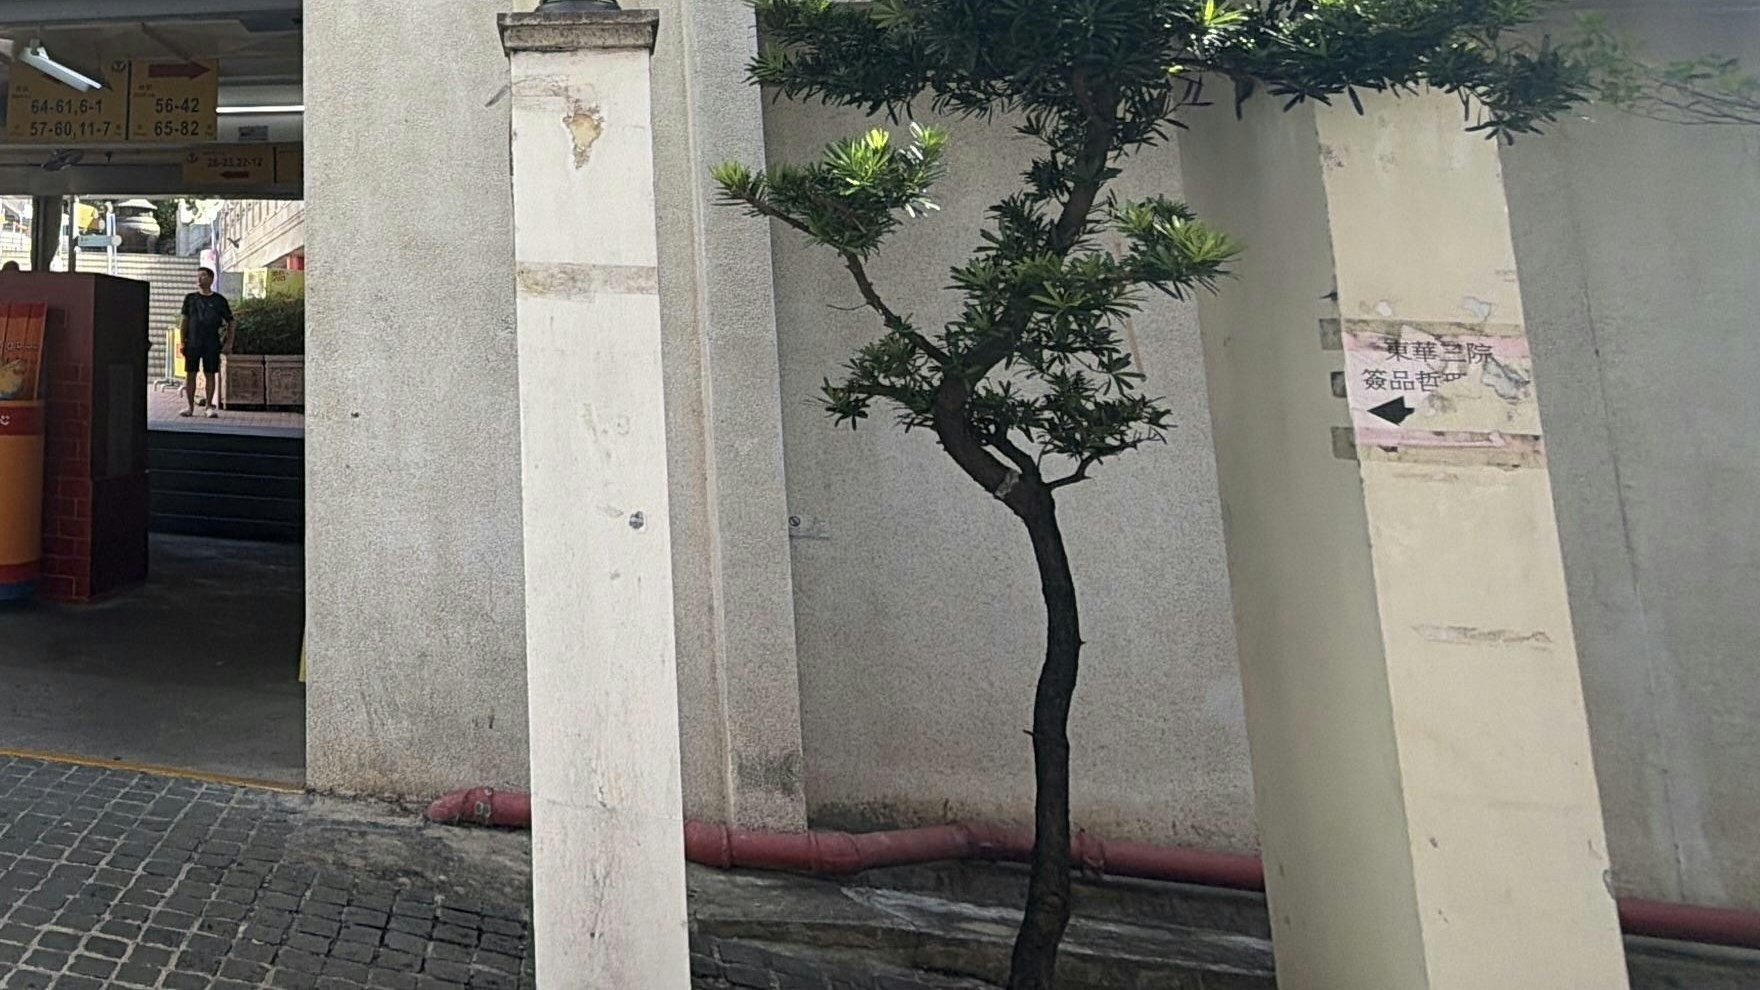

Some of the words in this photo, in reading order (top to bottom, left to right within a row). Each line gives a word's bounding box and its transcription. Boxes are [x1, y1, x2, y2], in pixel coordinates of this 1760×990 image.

[155, 97, 200, 114] 56-42
[30, 120, 111, 139] 57-60,11-7
[154, 120, 200, 137] 65-82
